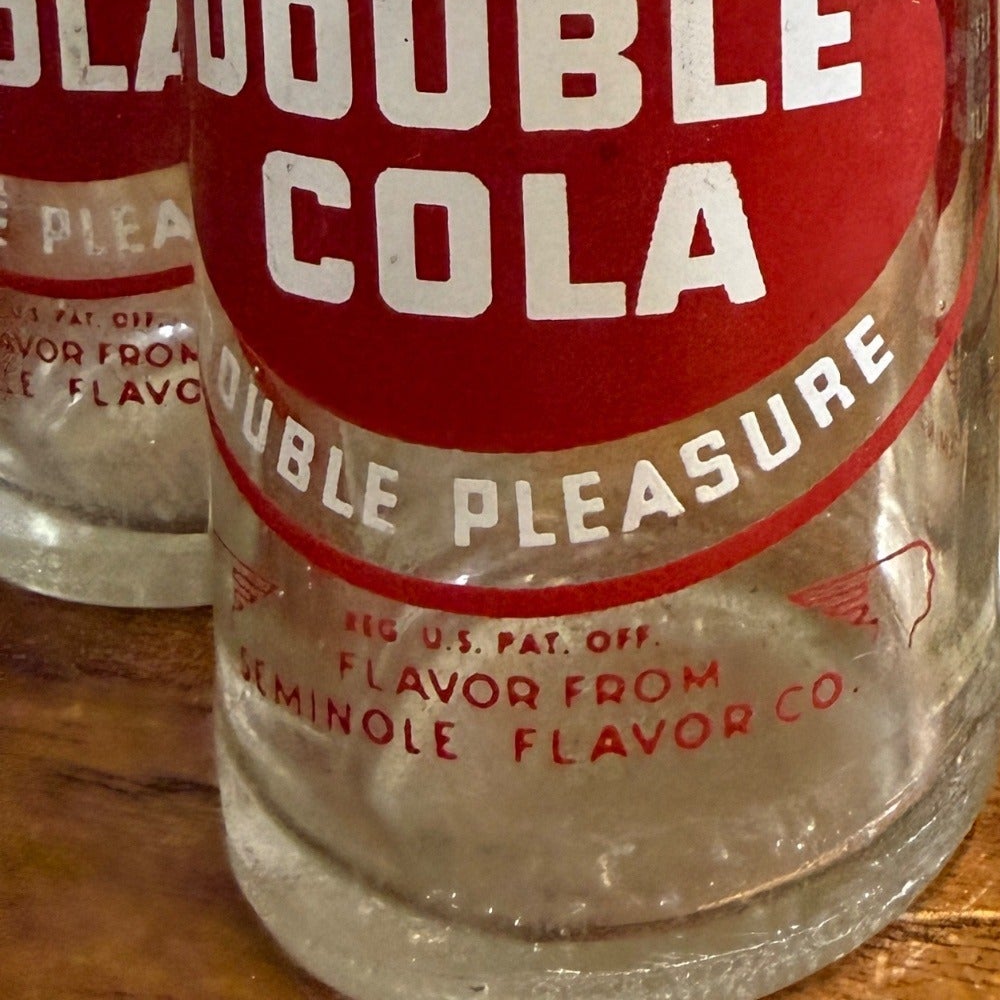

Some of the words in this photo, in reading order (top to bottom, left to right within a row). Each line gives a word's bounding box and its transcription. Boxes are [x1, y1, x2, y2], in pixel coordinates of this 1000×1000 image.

[262, 151, 767, 321] COLA
[453, 315, 895, 548] PLEASURE
[339, 651, 540, 711] FLAVOR
[565, 660, 720, 708] FROM
[423, 627, 482, 654] U.S.
[497, 631, 570, 655] PAT.
[586, 624, 660, 653] OFF.
[514, 704, 753, 764] FLAVOR
[775, 671, 859, 723] CO.
